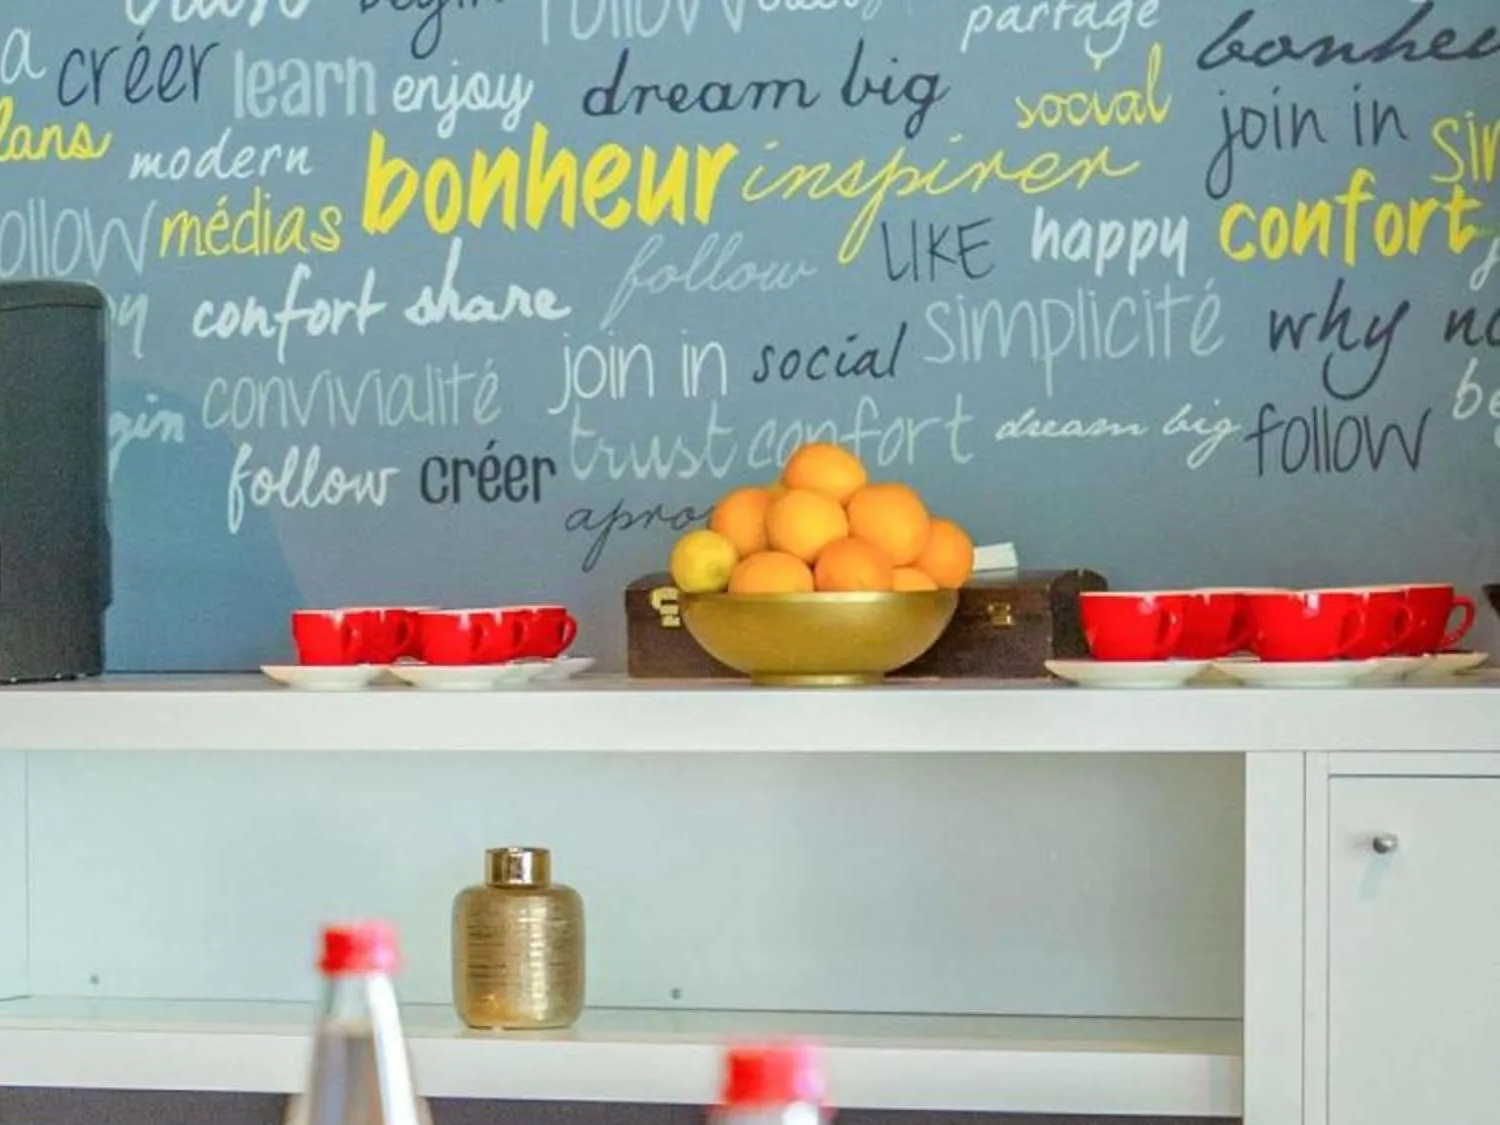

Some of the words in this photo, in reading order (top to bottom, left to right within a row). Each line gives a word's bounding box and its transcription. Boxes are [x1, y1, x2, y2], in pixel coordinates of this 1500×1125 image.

[57, 31, 221, 107] créer
[960, 0, 1161, 60] partage
[233, 48, 377, 119] learn
[392, 60, 534, 138] enjoy
[581, 47, 820, 117] dream
[840, 38, 950, 140] big
[1015, 42, 1172, 128] social
[128, 128, 314, 181] modern
[361, 121, 740, 236] bonheur
[1205, 85, 1328, 200] join
[1352, 83, 1409, 147] in
[160, 186, 344, 259] médias
[741, 134, 1142, 265] inspirer
[1219, 167, 1483, 268] confort
[599, 231, 818, 330] follow
[881, 217, 995, 283] LIKE
[1030, 206, 1189, 277] happy
[192, 262, 387, 364] confort
[404, 236, 572, 326] share
[924, 277, 1226, 396] simplicité
[1269, 278, 1410, 400] why
[547, 331, 655, 415] join
[681, 328, 729, 397] in
[752, 322, 908, 384] social
[203, 358, 502, 430] convivialité
[996, 406, 1148, 441] dream
[1162, 399, 1243, 470] big
[568, 400, 736, 481] trust
[1243, 402, 1433, 478] follow
[227, 444, 400, 535] follow
[420, 440, 558, 505] créer
